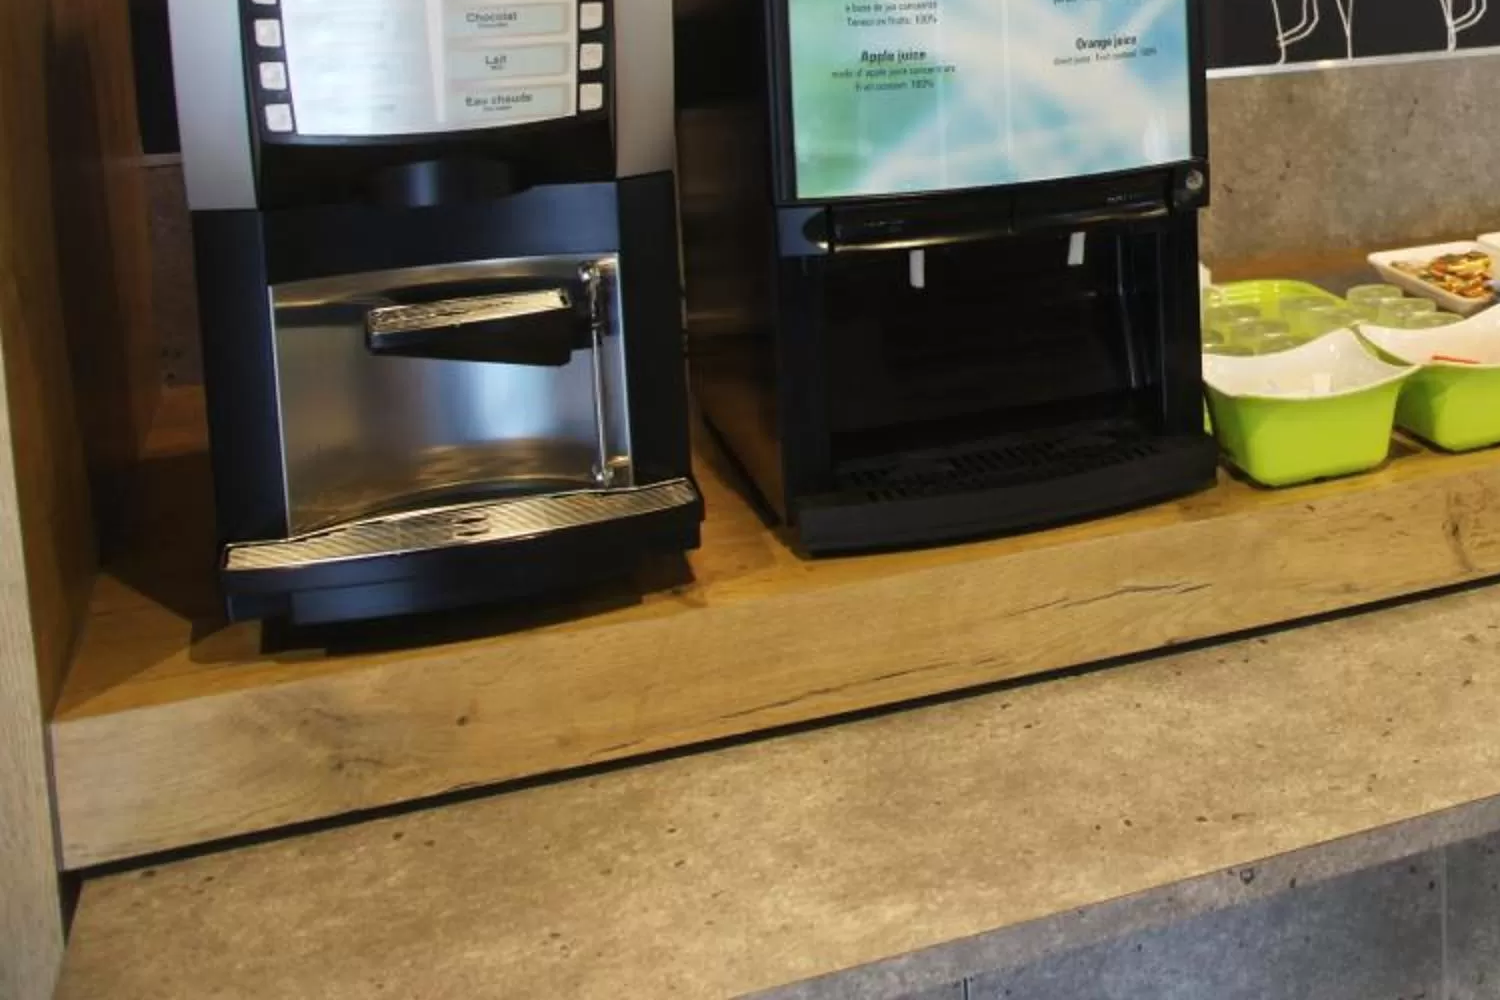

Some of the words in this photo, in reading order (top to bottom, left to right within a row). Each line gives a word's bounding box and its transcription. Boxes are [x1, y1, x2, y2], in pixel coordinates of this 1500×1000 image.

[465, 11, 518, 23] Chocolat
[1075, 36, 1112, 51] Orange
[860, 49, 895, 64] Apple
[896, 49, 927, 65] juice
